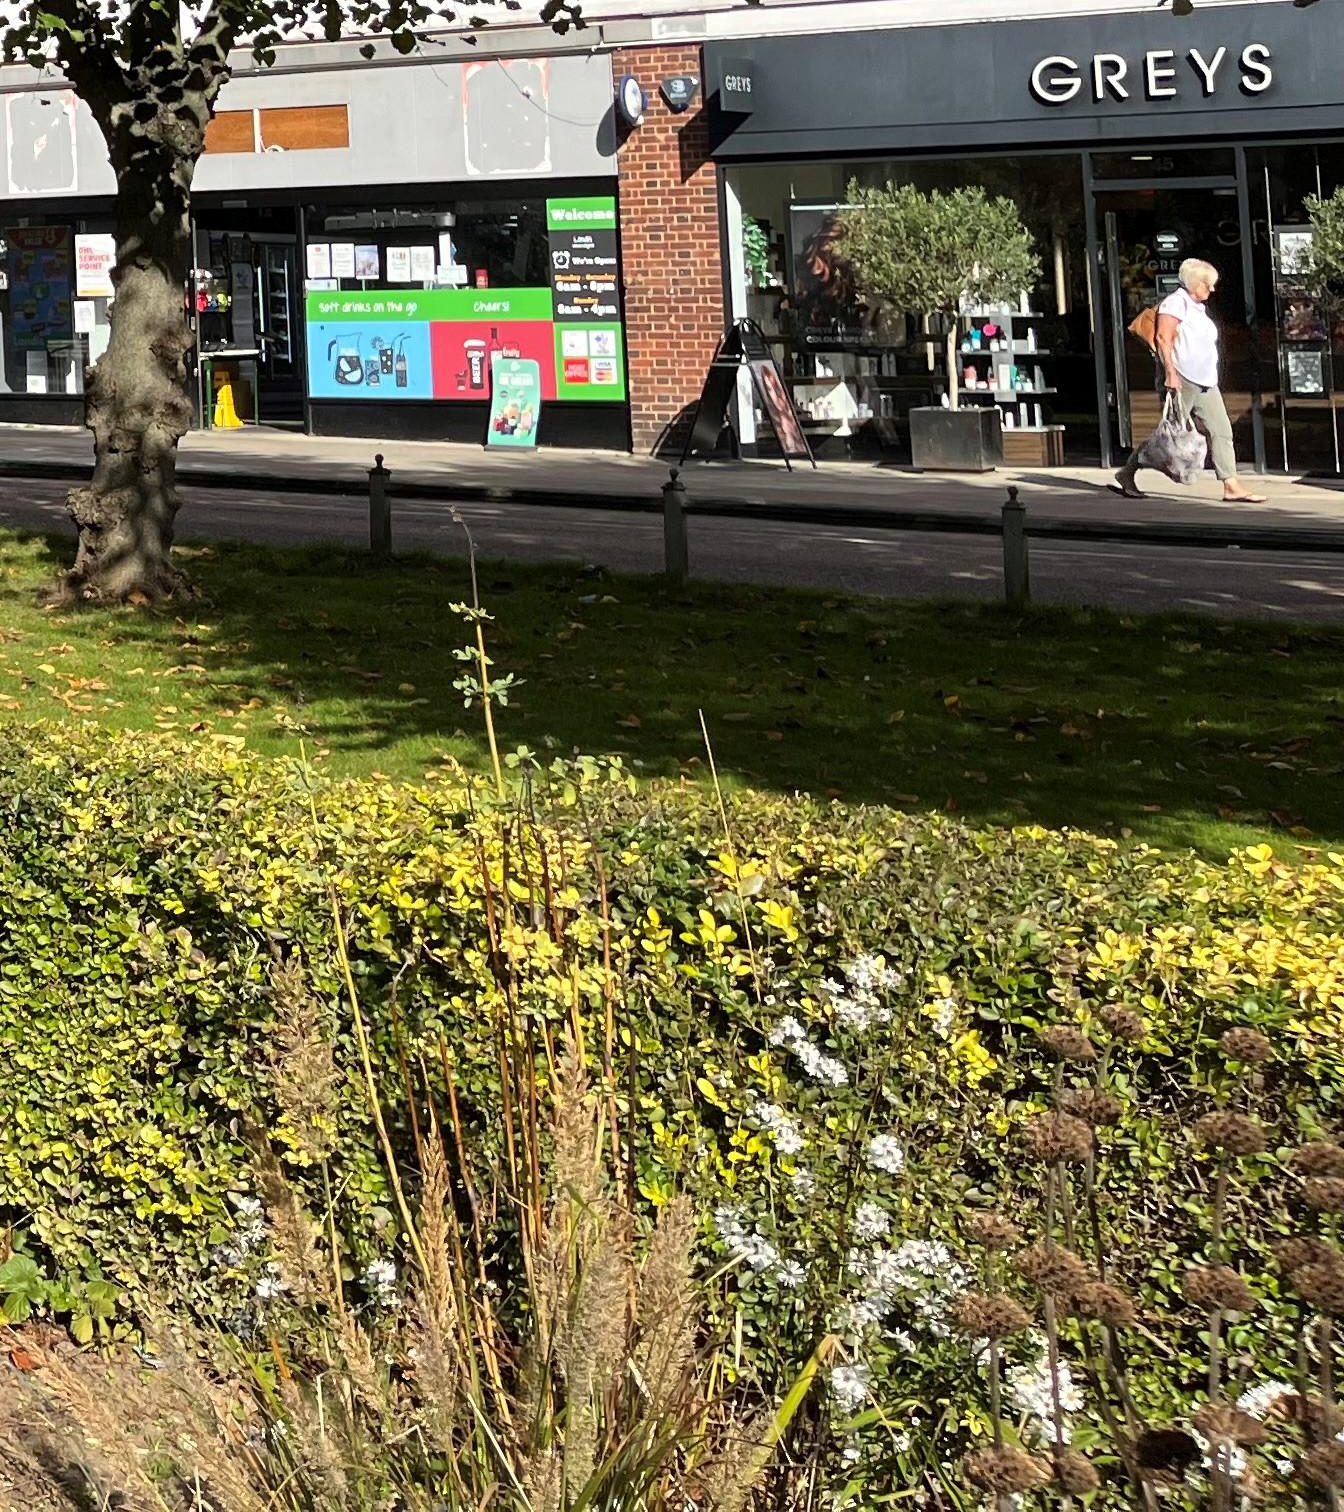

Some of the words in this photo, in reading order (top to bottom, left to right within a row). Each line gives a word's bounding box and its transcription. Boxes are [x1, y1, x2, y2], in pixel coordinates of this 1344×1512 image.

[1031, 43, 1273, 102] GREYS
[725, 74, 752, 93] GREYS
[550, 208, 615, 221] Welcome
[79, 254, 110, 262] SERVICE
[79, 262, 102, 270] POINT
[318, 302, 340, 313] soft
[342, 301, 371, 313] drinks
[373, 303, 385, 313] on
[386, 301, 403, 313] the
[405, 302, 418, 316] go
